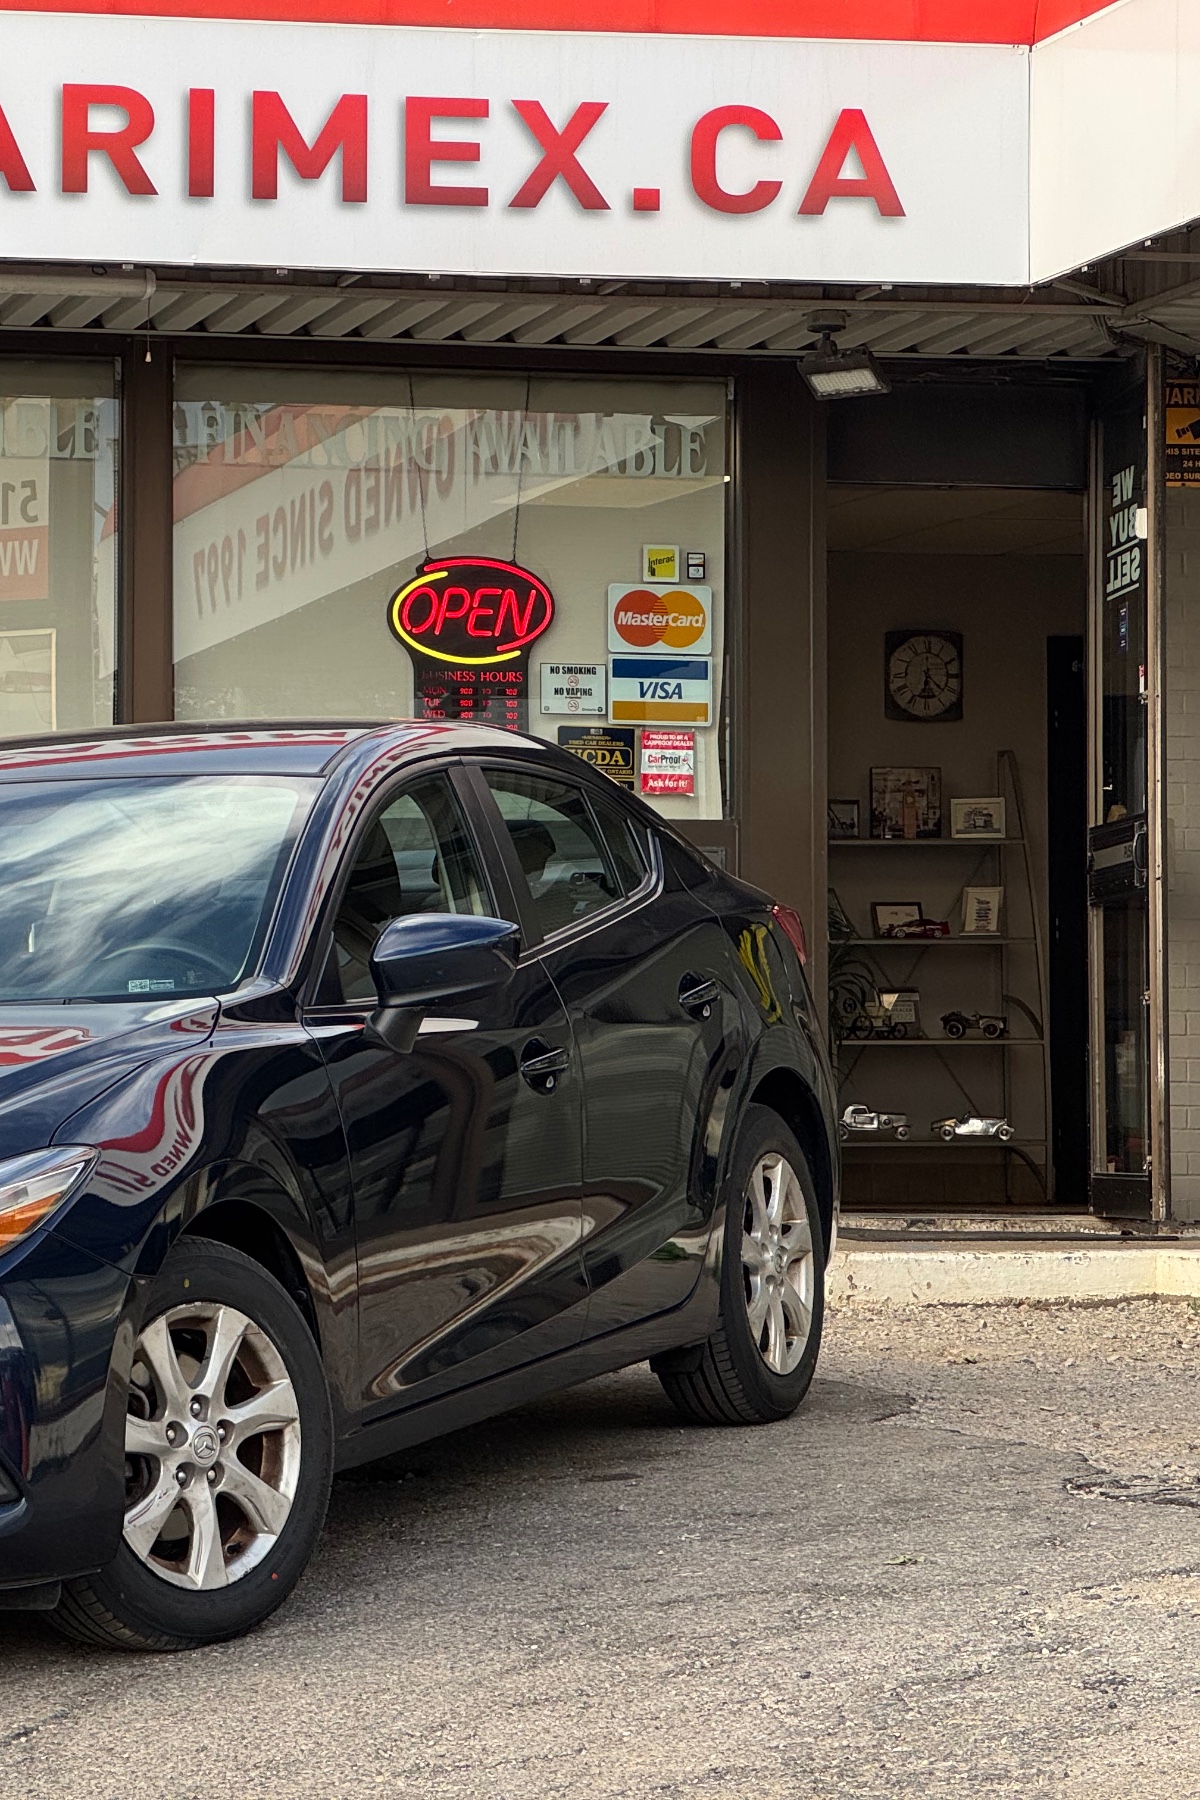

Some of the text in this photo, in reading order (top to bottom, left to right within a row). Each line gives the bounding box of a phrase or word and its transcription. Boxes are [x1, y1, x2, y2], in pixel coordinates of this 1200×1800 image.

[1166, 387, 1200, 405] AR
[196, 408, 708, 479] FINANCING AVAILABLE
[1166, 447, 1179, 456] HIS
[1183, 460, 1193, 468] 24
[648, 555, 675, 566] Interac
[400, 587, 537, 637] OPEN
[617, 611, 705, 628] MasterCard
[550, 666, 597, 675] NO SMOKING
[422, 671, 523, 682] BUSINESS HOURS
[554, 687, 593, 697] NO VAPING
[638, 681, 684, 700] VISA
[647, 754, 681, 765] CarProof
[647, 778, 664, 788] Ask
[664, 778, 678, 788] for
